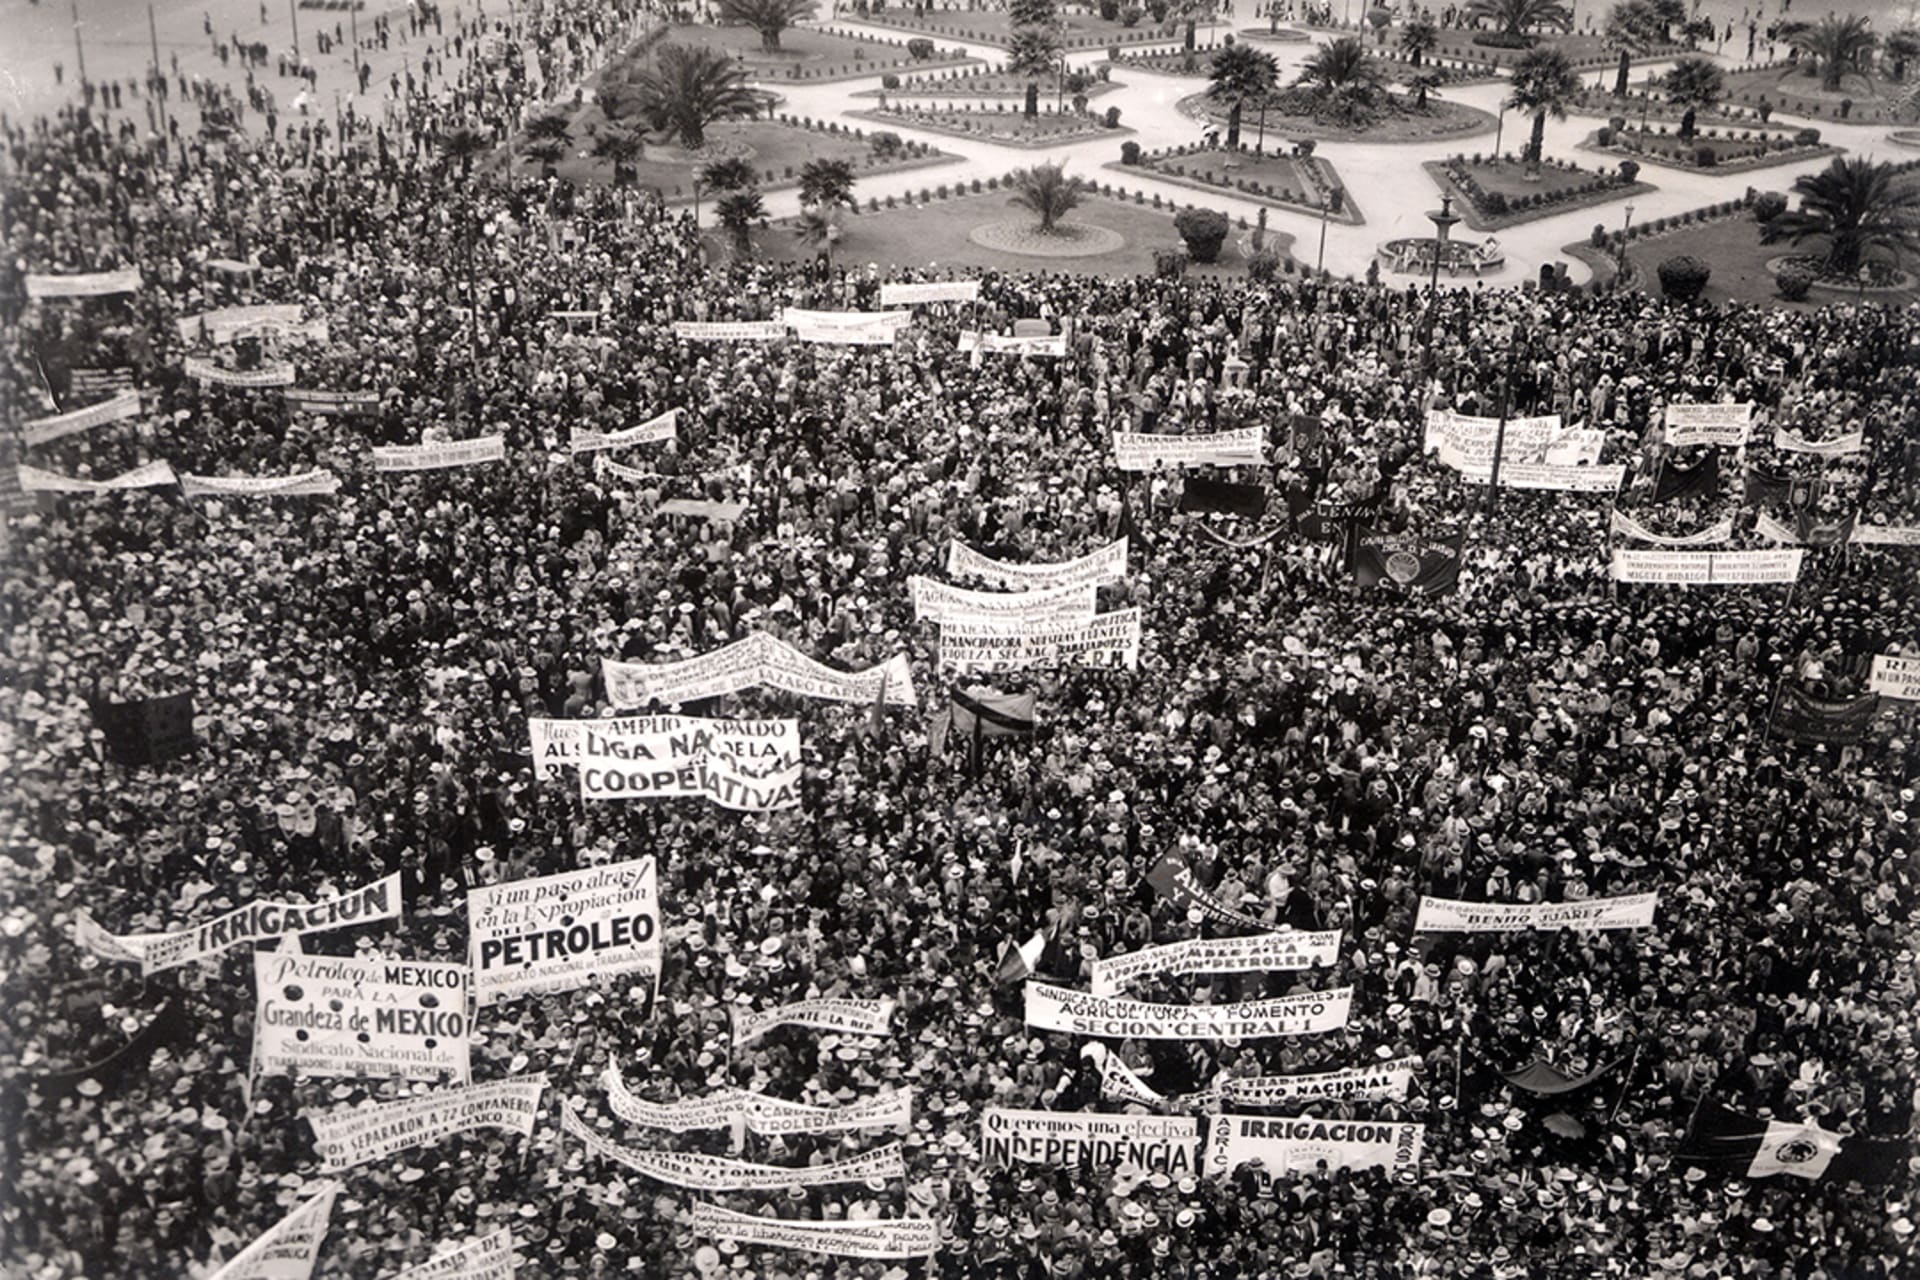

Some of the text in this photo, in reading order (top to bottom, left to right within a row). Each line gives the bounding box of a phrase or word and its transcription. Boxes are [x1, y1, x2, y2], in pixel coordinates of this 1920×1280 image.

[587, 731, 656, 760] LIGA
[200, 882, 390, 949] IRRIGACION
[480, 913, 654, 970] PETROLEO
[384, 965, 460, 989] MEXICO
[321, 985, 398, 1004] PARA LA
[263, 999, 464, 1038] Grandeza de MEXICO
[1226, 1003, 1326, 1020] FOMENTO
[280, 1038, 455, 1063] Sindicato Nacional de
[1296, 1076, 1393, 1096] NACIONAL
[350, 1115, 424, 1150] SEPARARON
[987, 1113, 1084, 1135] Queremos
[1087, 1122, 1121, 1135] una
[1240, 1119, 1393, 1144] IRRIGACION
[984, 1136, 1189, 1174] INDEPENDENCIA
